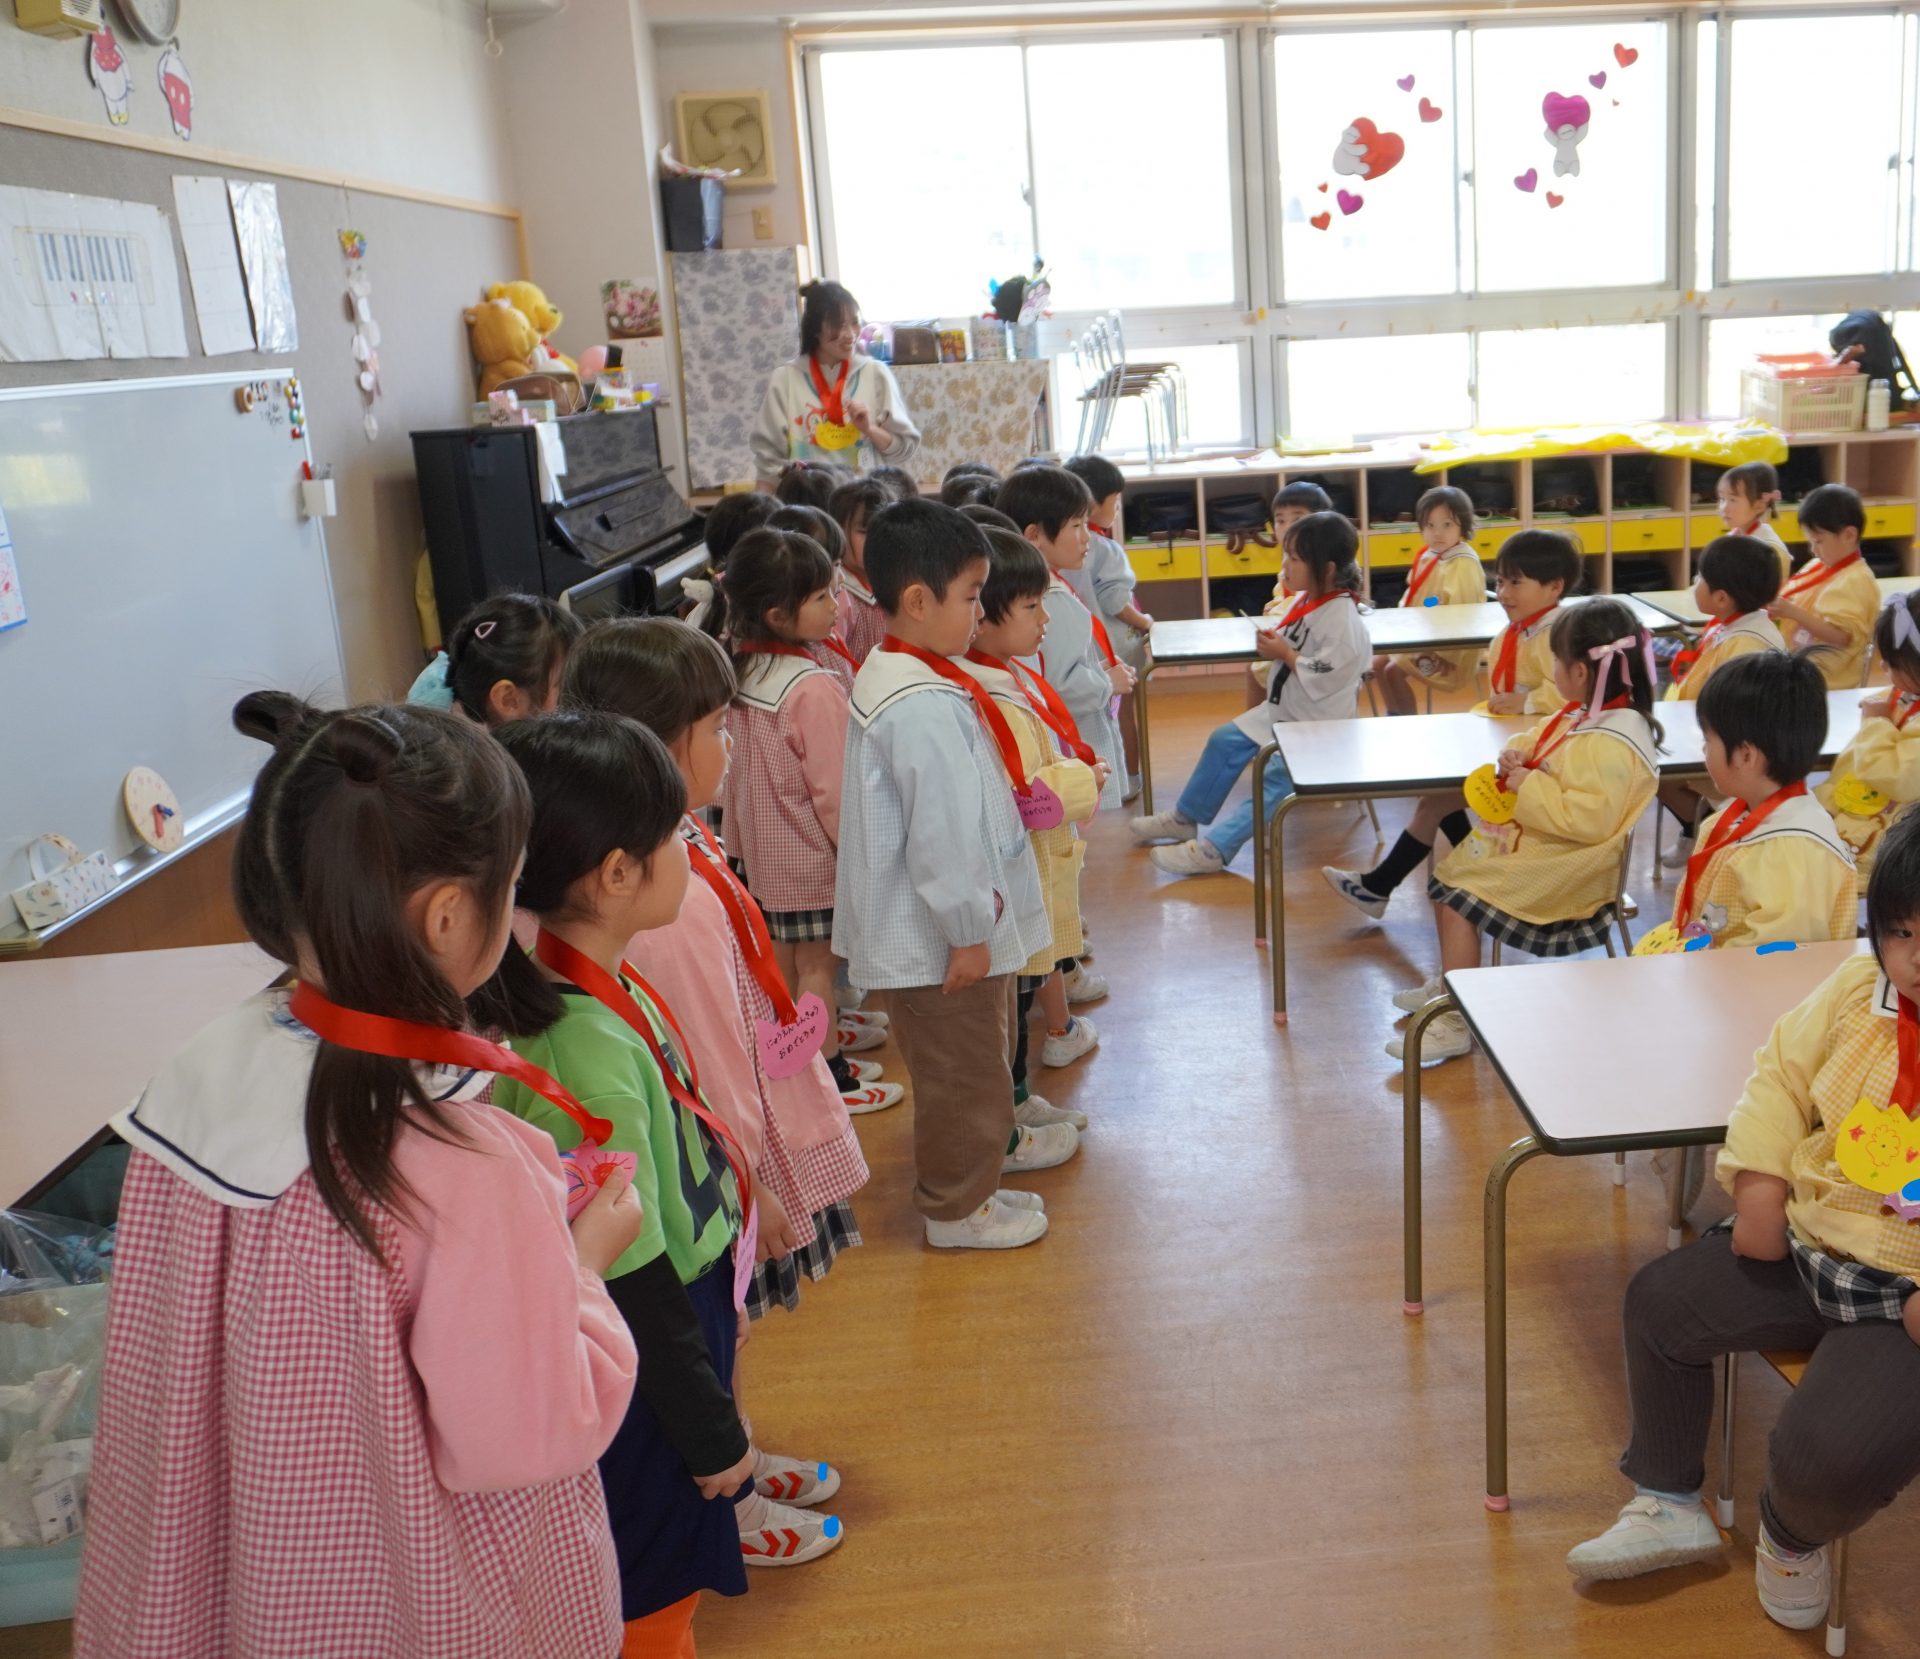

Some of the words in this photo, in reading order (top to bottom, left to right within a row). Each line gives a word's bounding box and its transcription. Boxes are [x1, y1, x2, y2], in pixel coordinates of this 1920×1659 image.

[766, 1025, 794, 1050] にゅうえん
[779, 1030, 809, 1060] おめでとう
